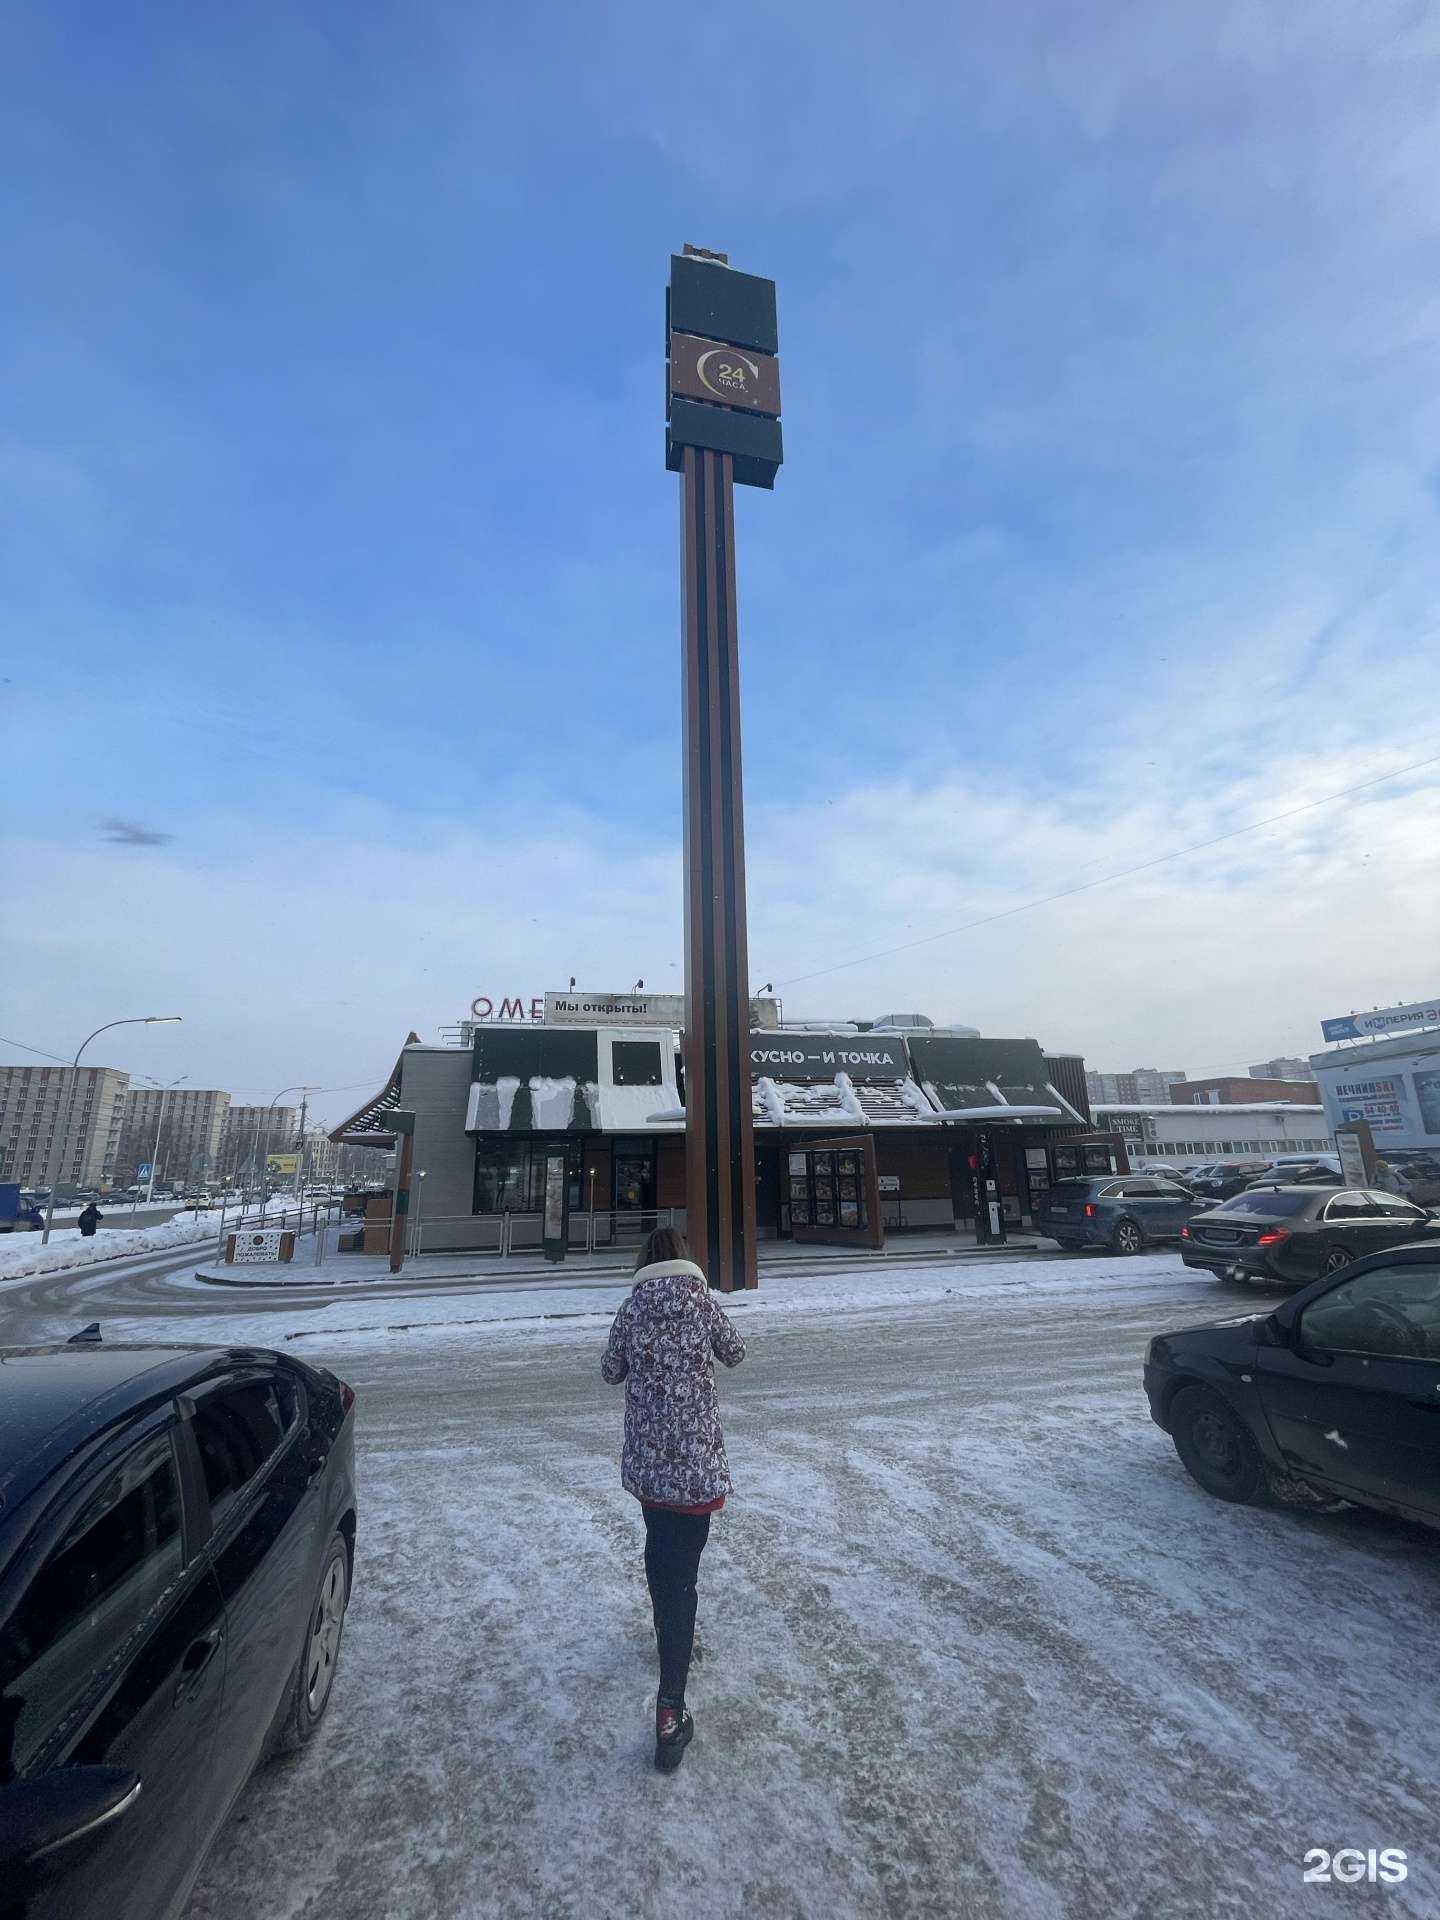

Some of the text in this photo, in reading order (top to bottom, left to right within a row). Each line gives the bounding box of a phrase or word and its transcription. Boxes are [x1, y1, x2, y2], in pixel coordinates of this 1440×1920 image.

[718, 364, 746, 383] 24
[718, 377, 746, 391] ЧАСА
[555, 1000, 648, 1014] Мы открыты!
[823, 1051, 836, 1064] И
[838, 1052, 894, 1065] ТОЧКА
